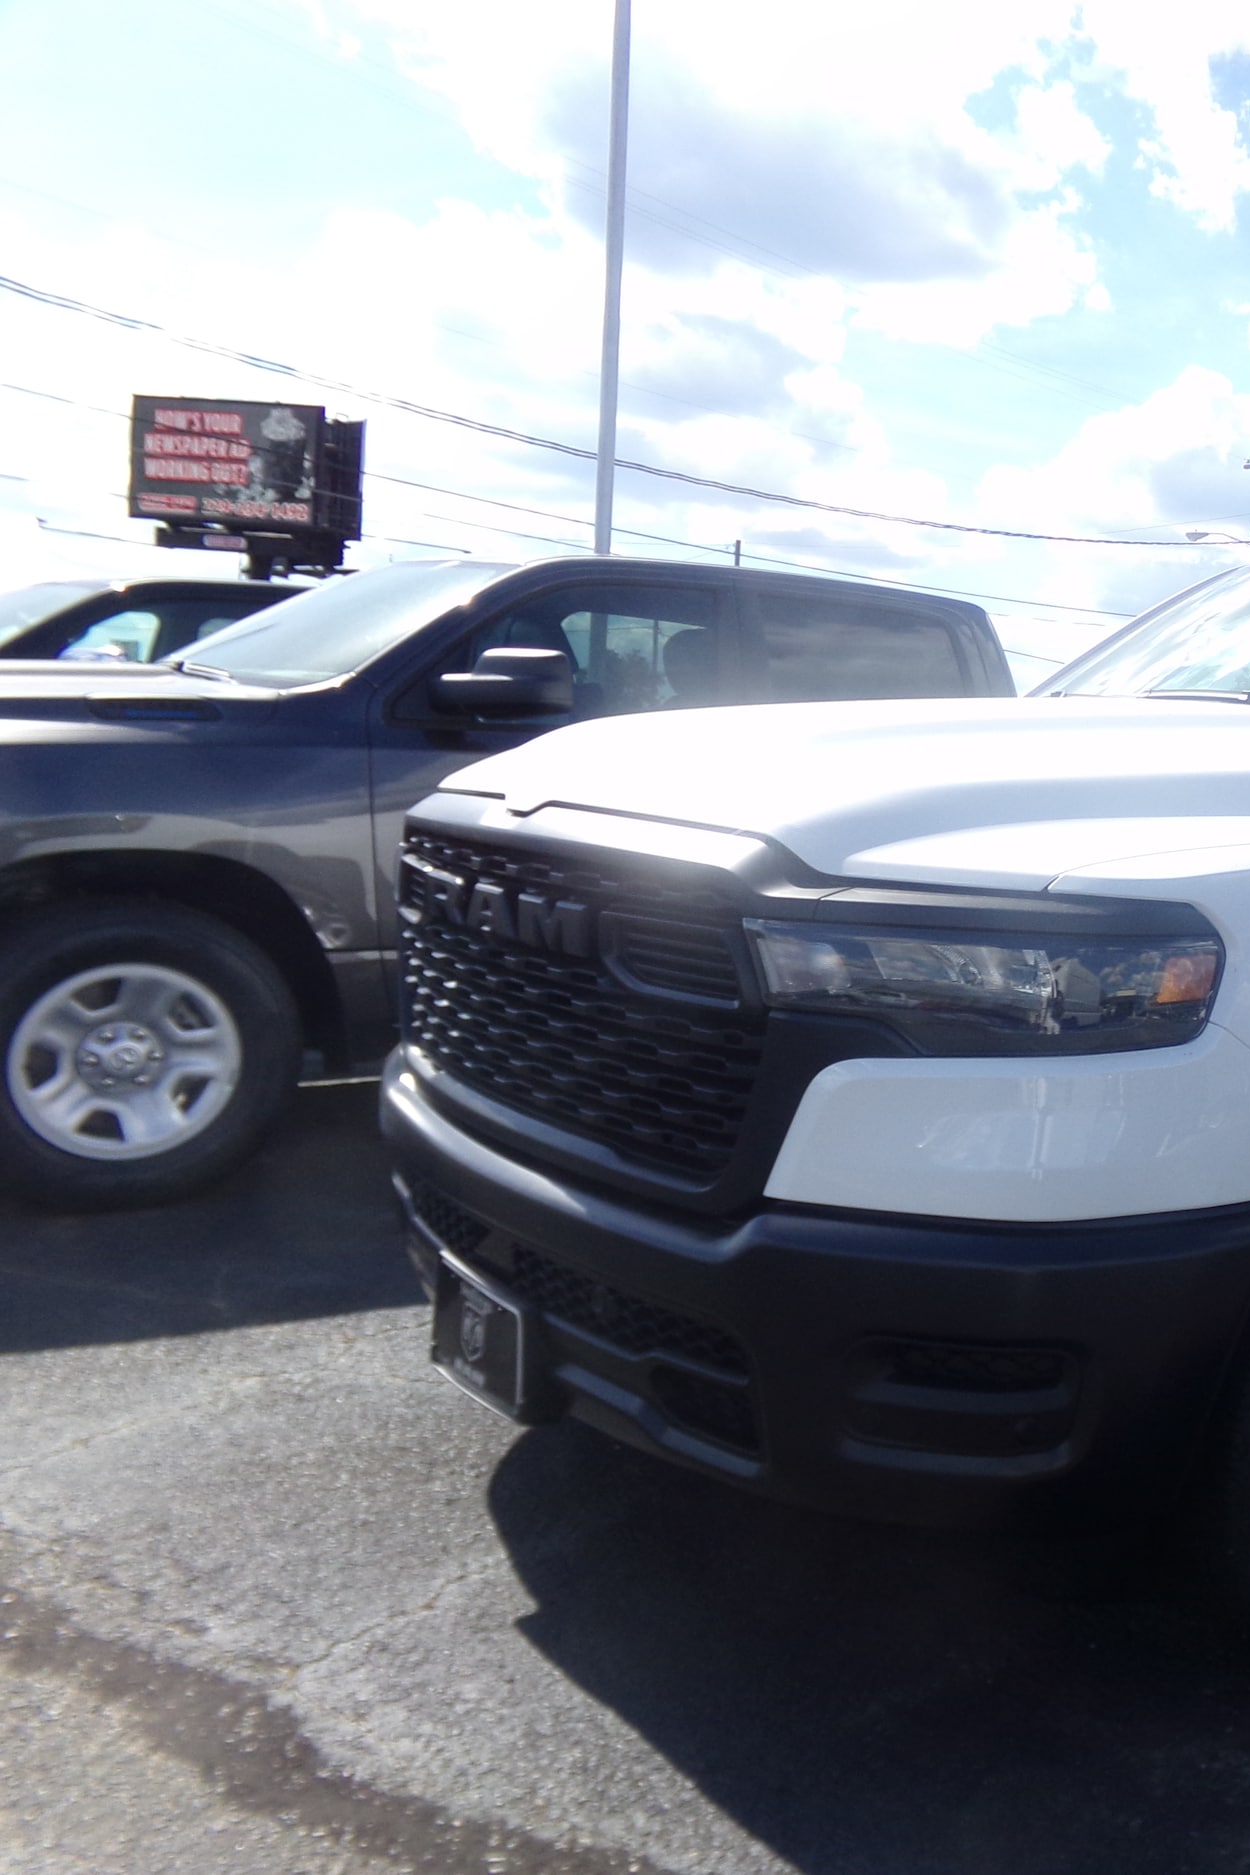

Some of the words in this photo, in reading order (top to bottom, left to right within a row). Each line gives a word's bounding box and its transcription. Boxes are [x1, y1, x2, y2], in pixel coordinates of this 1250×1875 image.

[203, 411, 241, 435] YOUR
[144, 433, 227, 458] NEWSPAPER
[144, 457, 210, 481] WORKING
[425, 868, 590, 957] RAM
